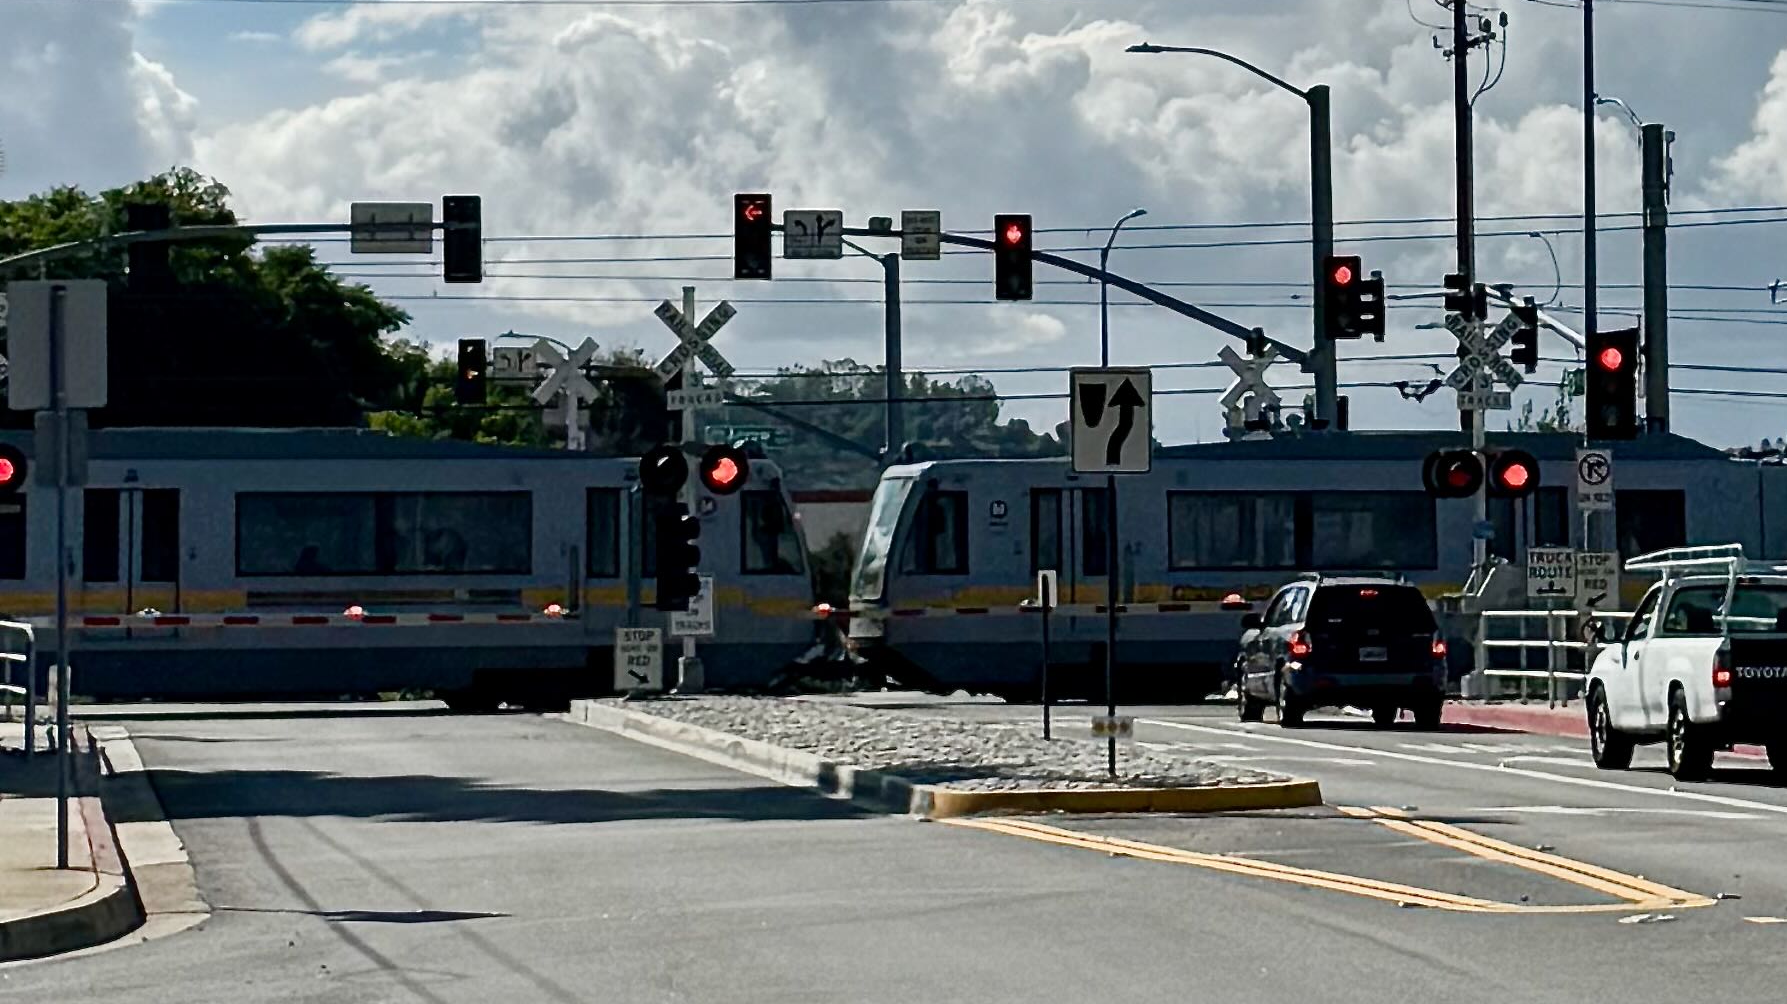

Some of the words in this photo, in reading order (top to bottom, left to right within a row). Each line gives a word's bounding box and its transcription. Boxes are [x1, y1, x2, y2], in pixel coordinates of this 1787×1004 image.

[1450, 316, 1518, 386] CROSSING
[1529, 552, 1572, 563] TRUCK
[1581, 555, 1610, 565] STOP
[1529, 566, 1572, 578] ROUTE
[1584, 579, 1608, 590] RED
[624, 630, 655, 641] STOP
[628, 656, 651, 666] RED
